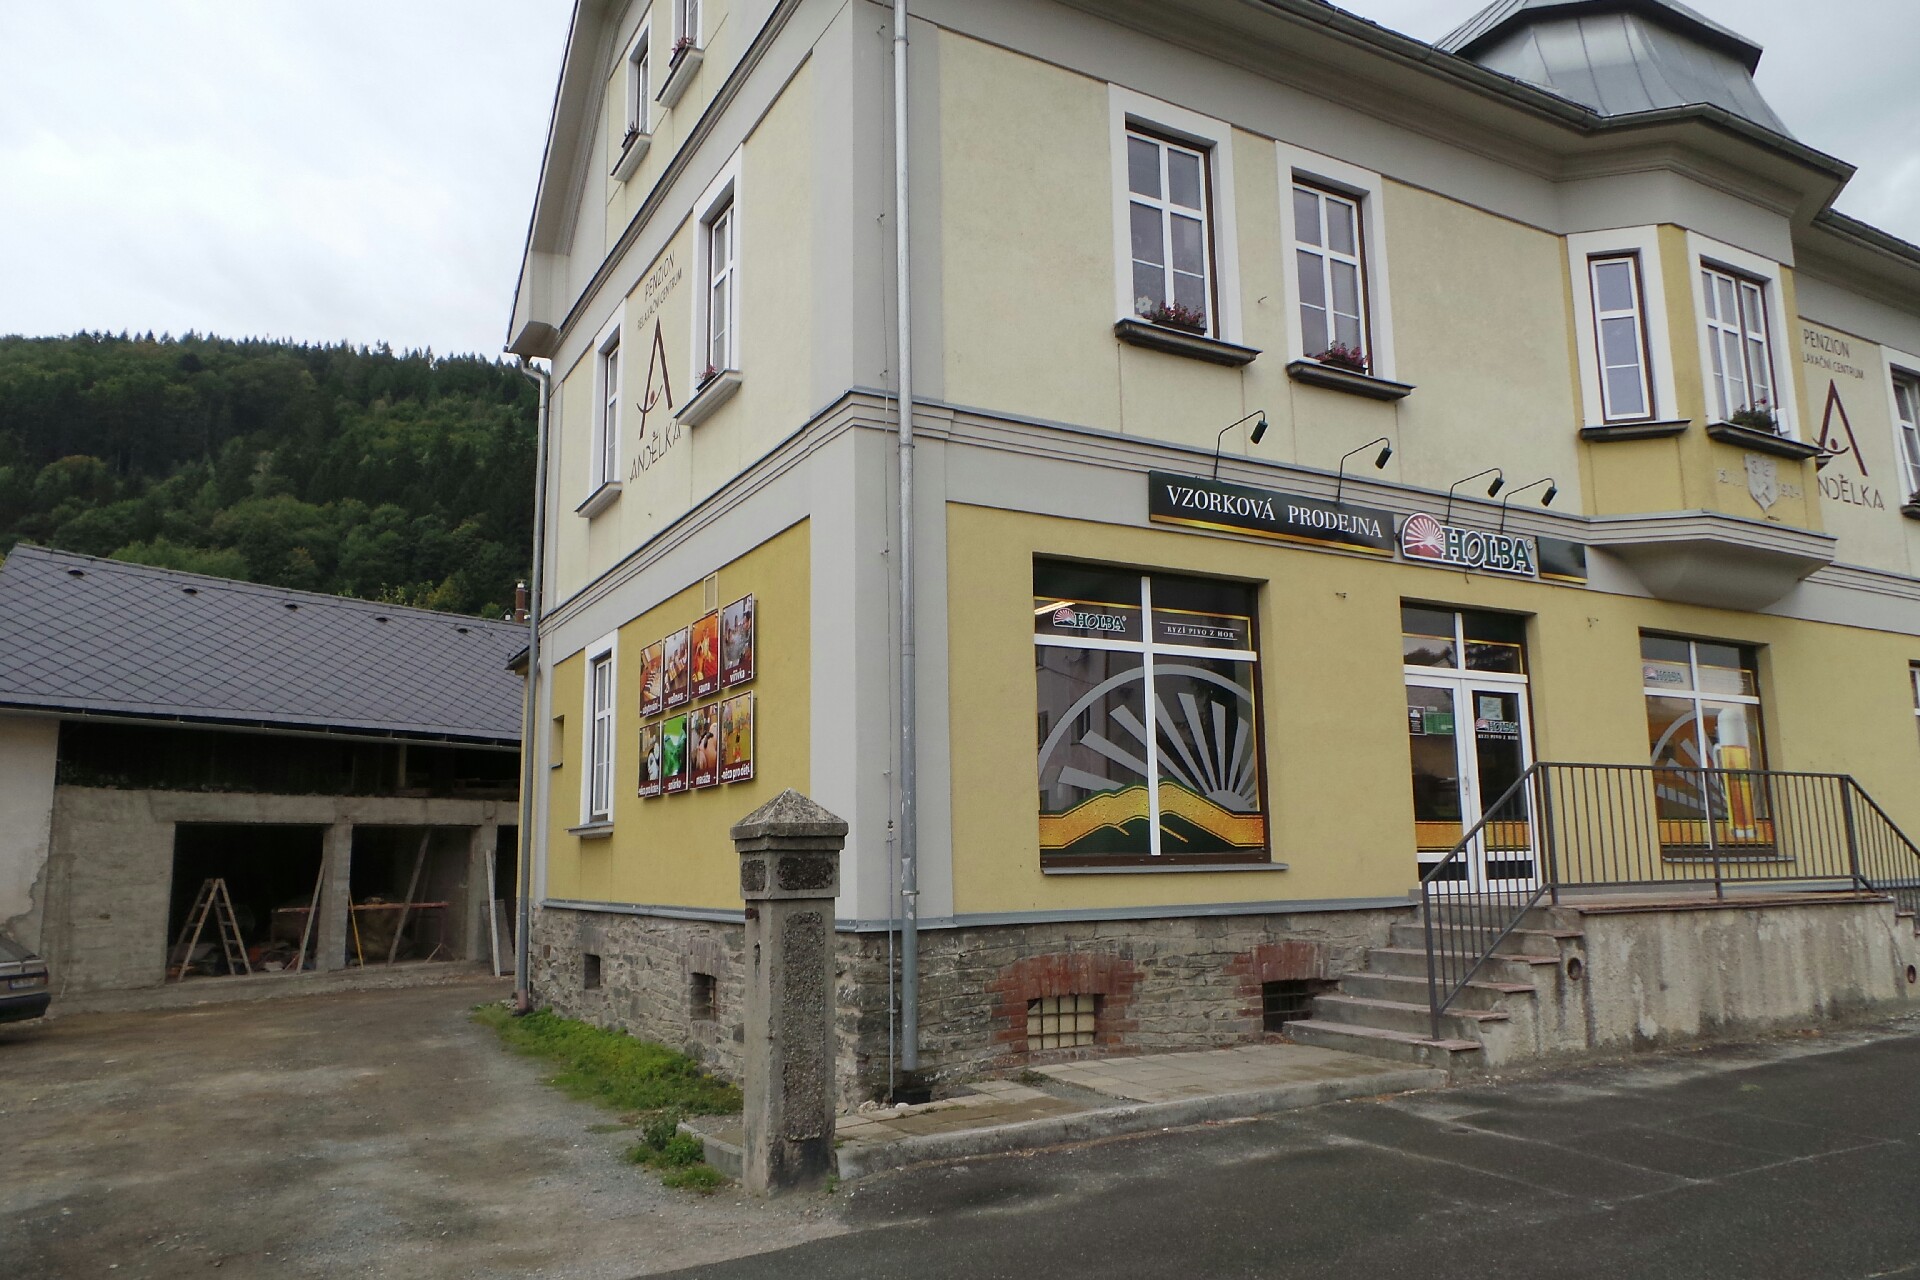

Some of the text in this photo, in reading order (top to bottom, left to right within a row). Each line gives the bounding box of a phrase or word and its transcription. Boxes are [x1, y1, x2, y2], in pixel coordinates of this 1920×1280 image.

[644, 249, 675, 302] PENZION
[660, 266, 682, 304] CENTRUM
[1803, 328, 1850, 358] PENZION
[1802, 351, 1864, 380] LAXAČNÍ CENTRUM
[1166, 484, 1384, 538] VZORKOVÁ PRODEJNA
[1817, 473, 1884, 511] NDĚLKA
[1441, 525, 1535, 577] HOLBA
[1073, 611, 1126, 632] HOLBA
[1188, 627, 1207, 636] PIVO
[1209, 629, 1215, 637] Z
[1217, 631, 1234, 639] HOR
